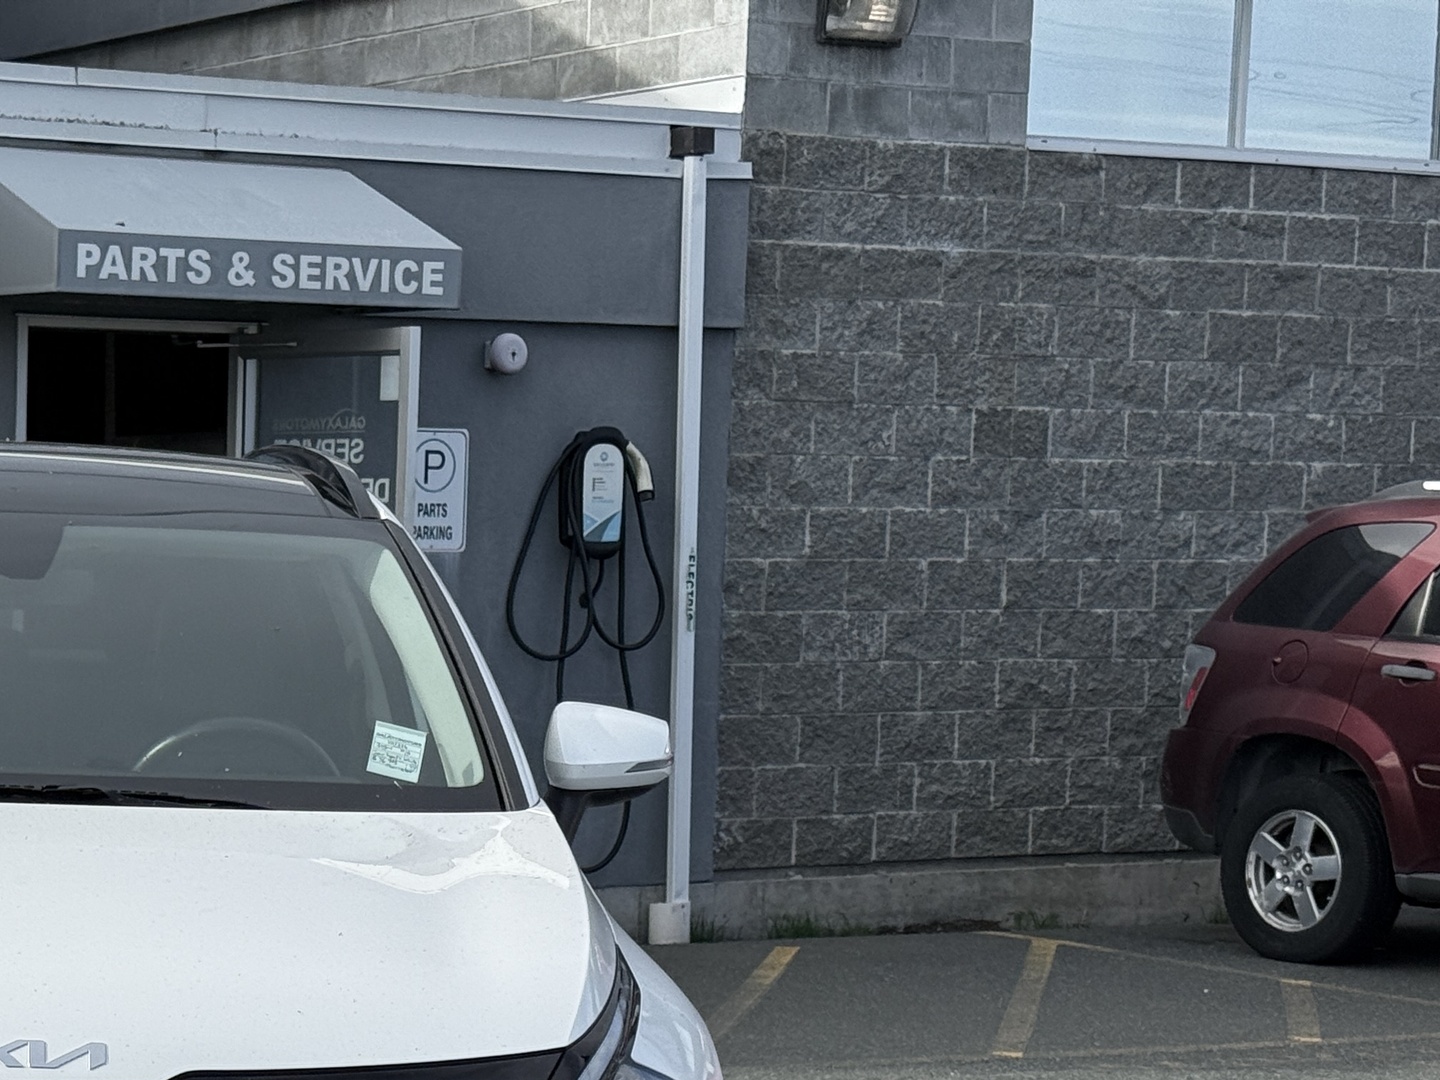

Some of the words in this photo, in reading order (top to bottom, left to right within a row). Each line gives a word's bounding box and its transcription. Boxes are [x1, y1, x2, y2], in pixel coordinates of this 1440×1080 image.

[76, 243, 212, 285] PARTS
[227, 251, 257, 287] &
[271, 253, 445, 296] SERVICE
[417, 503, 448, 518] PARTS
